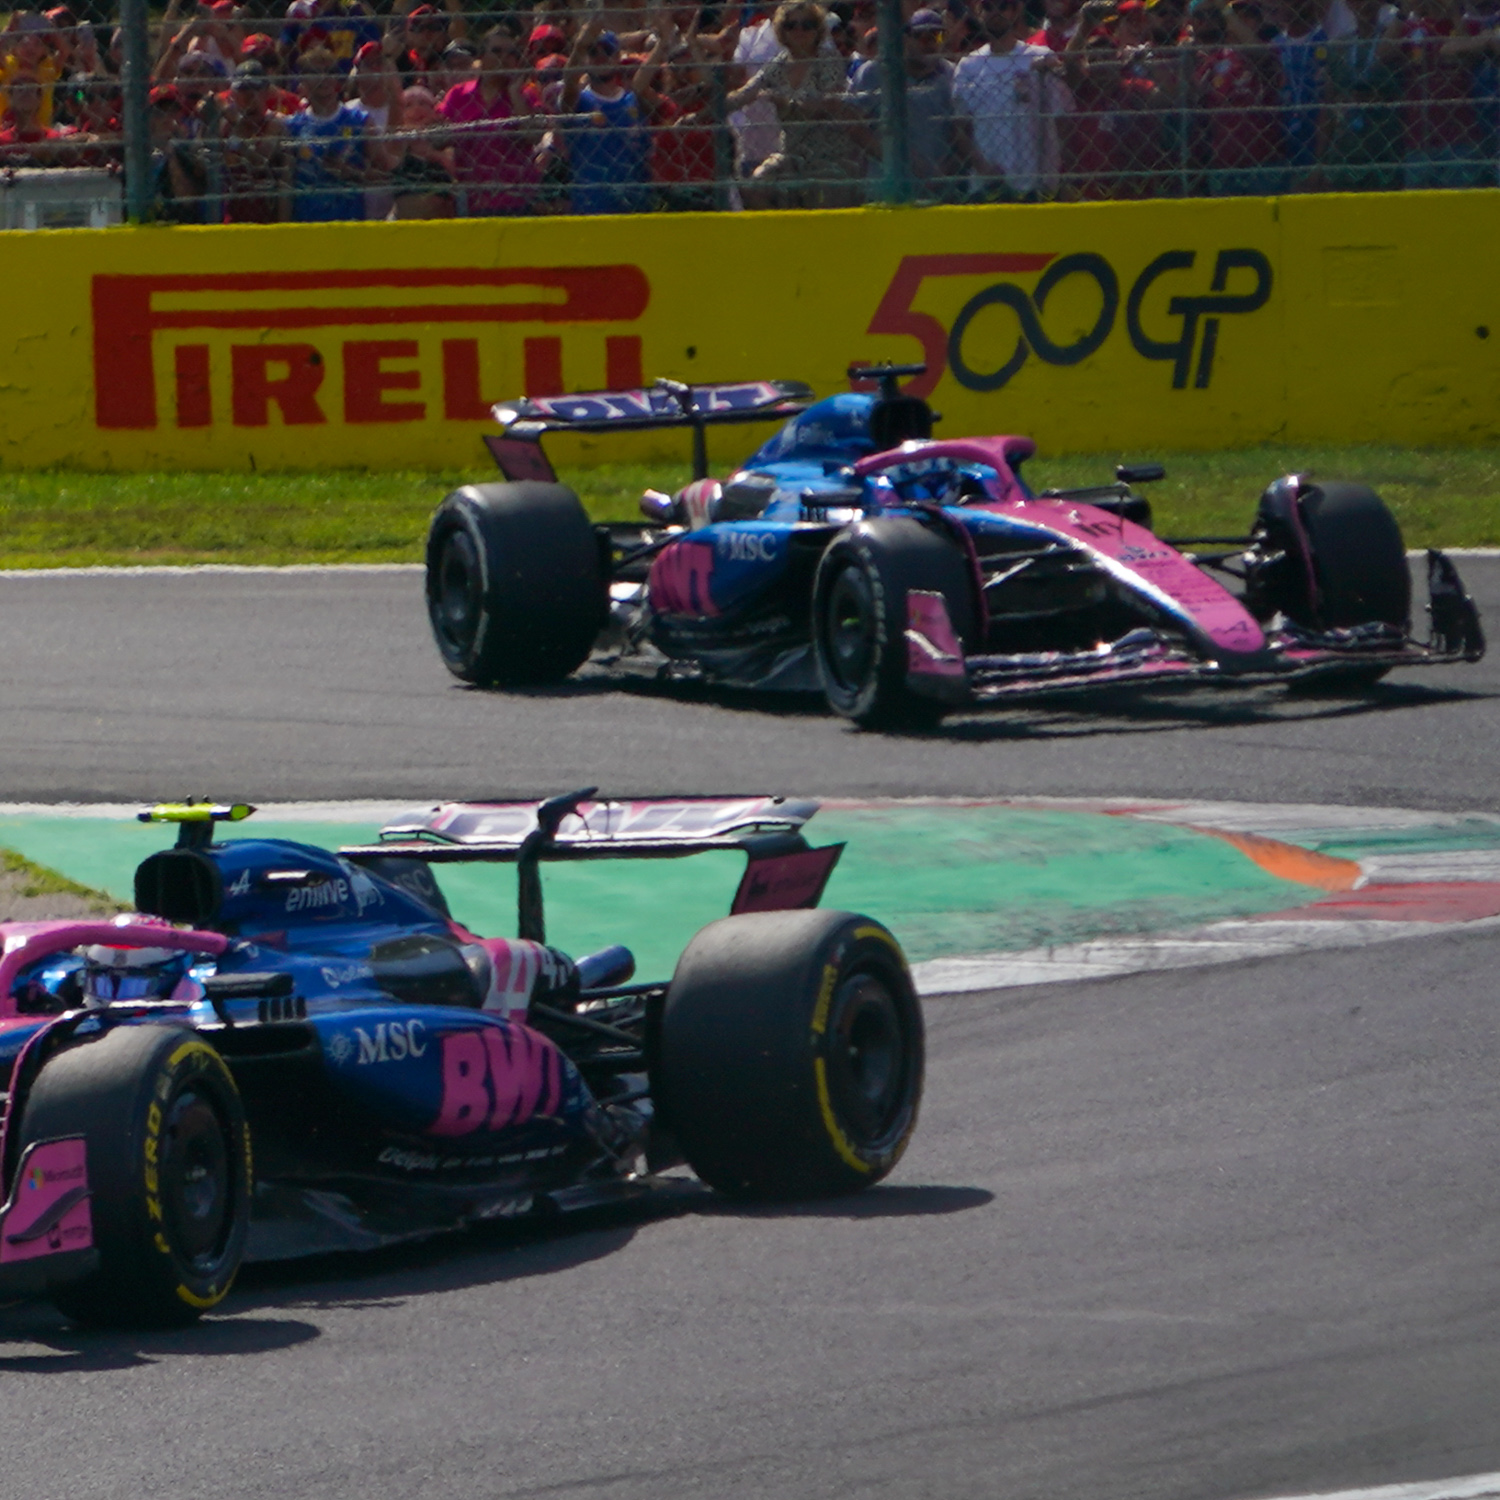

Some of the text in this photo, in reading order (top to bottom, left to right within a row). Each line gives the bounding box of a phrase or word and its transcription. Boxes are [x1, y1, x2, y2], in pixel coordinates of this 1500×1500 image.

[91, 264, 650, 430] PIRELLI
[730, 531, 777, 561] MSC
[354, 1019, 427, 1065] MSC
